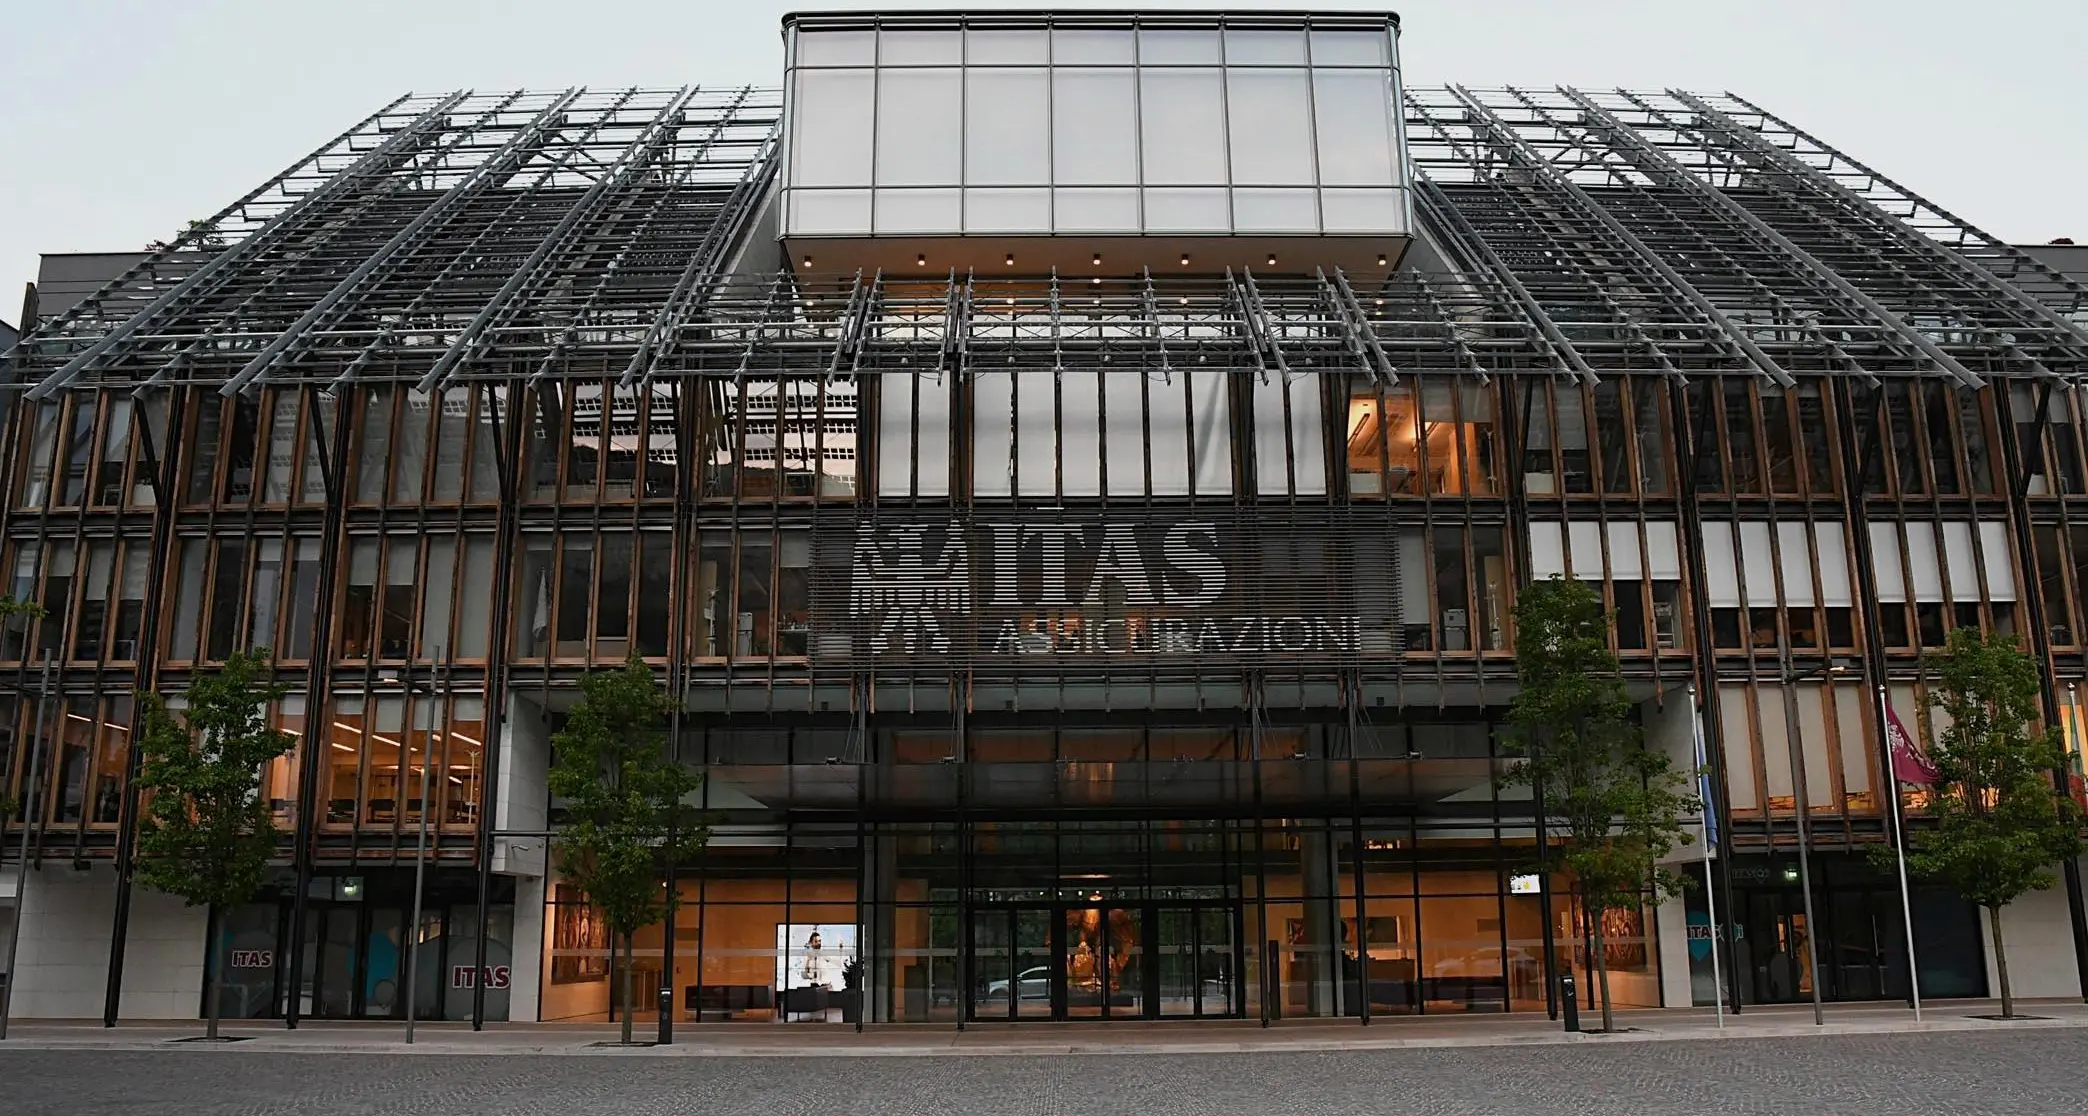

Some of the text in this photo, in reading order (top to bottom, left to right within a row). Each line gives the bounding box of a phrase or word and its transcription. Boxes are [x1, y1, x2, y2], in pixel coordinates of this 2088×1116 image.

[975, 520, 1227, 608] ITAS
[992, 616, 1361, 654] ASSICURAZIONI
[232, 950, 272, 967] ITAS
